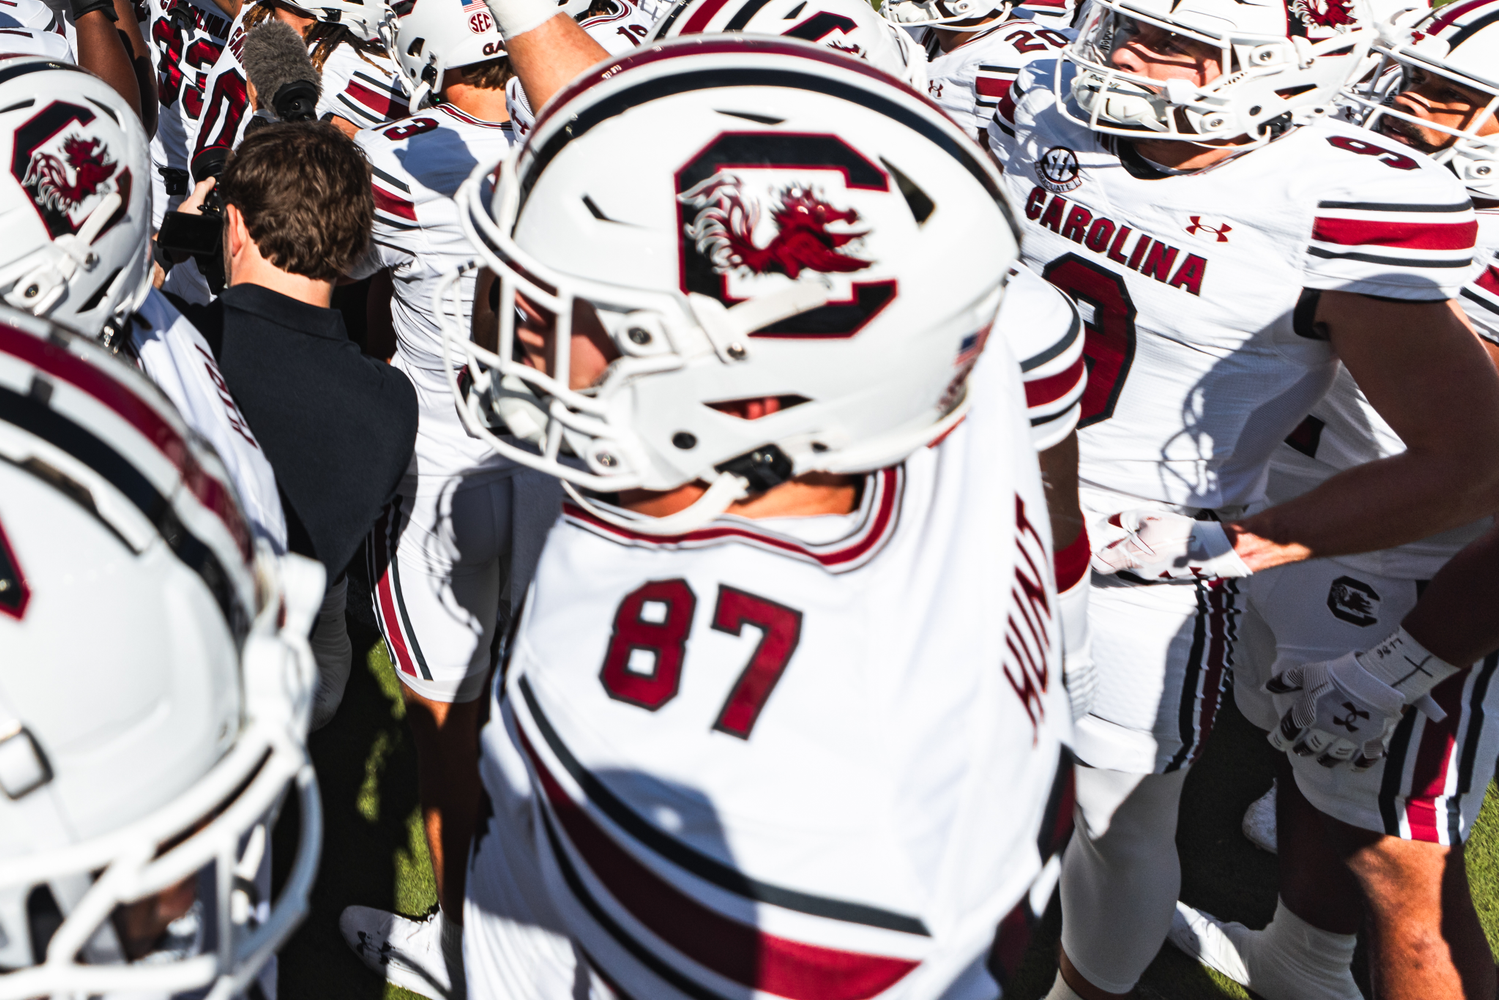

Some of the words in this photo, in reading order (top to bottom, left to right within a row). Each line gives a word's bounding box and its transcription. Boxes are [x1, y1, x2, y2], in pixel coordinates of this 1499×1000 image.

[470, 13, 492, 33] SEC
[1003, 28, 1070, 55] 20
[1025, 186, 1209, 297] CAROLINA
[598, 577, 804, 742] 87
